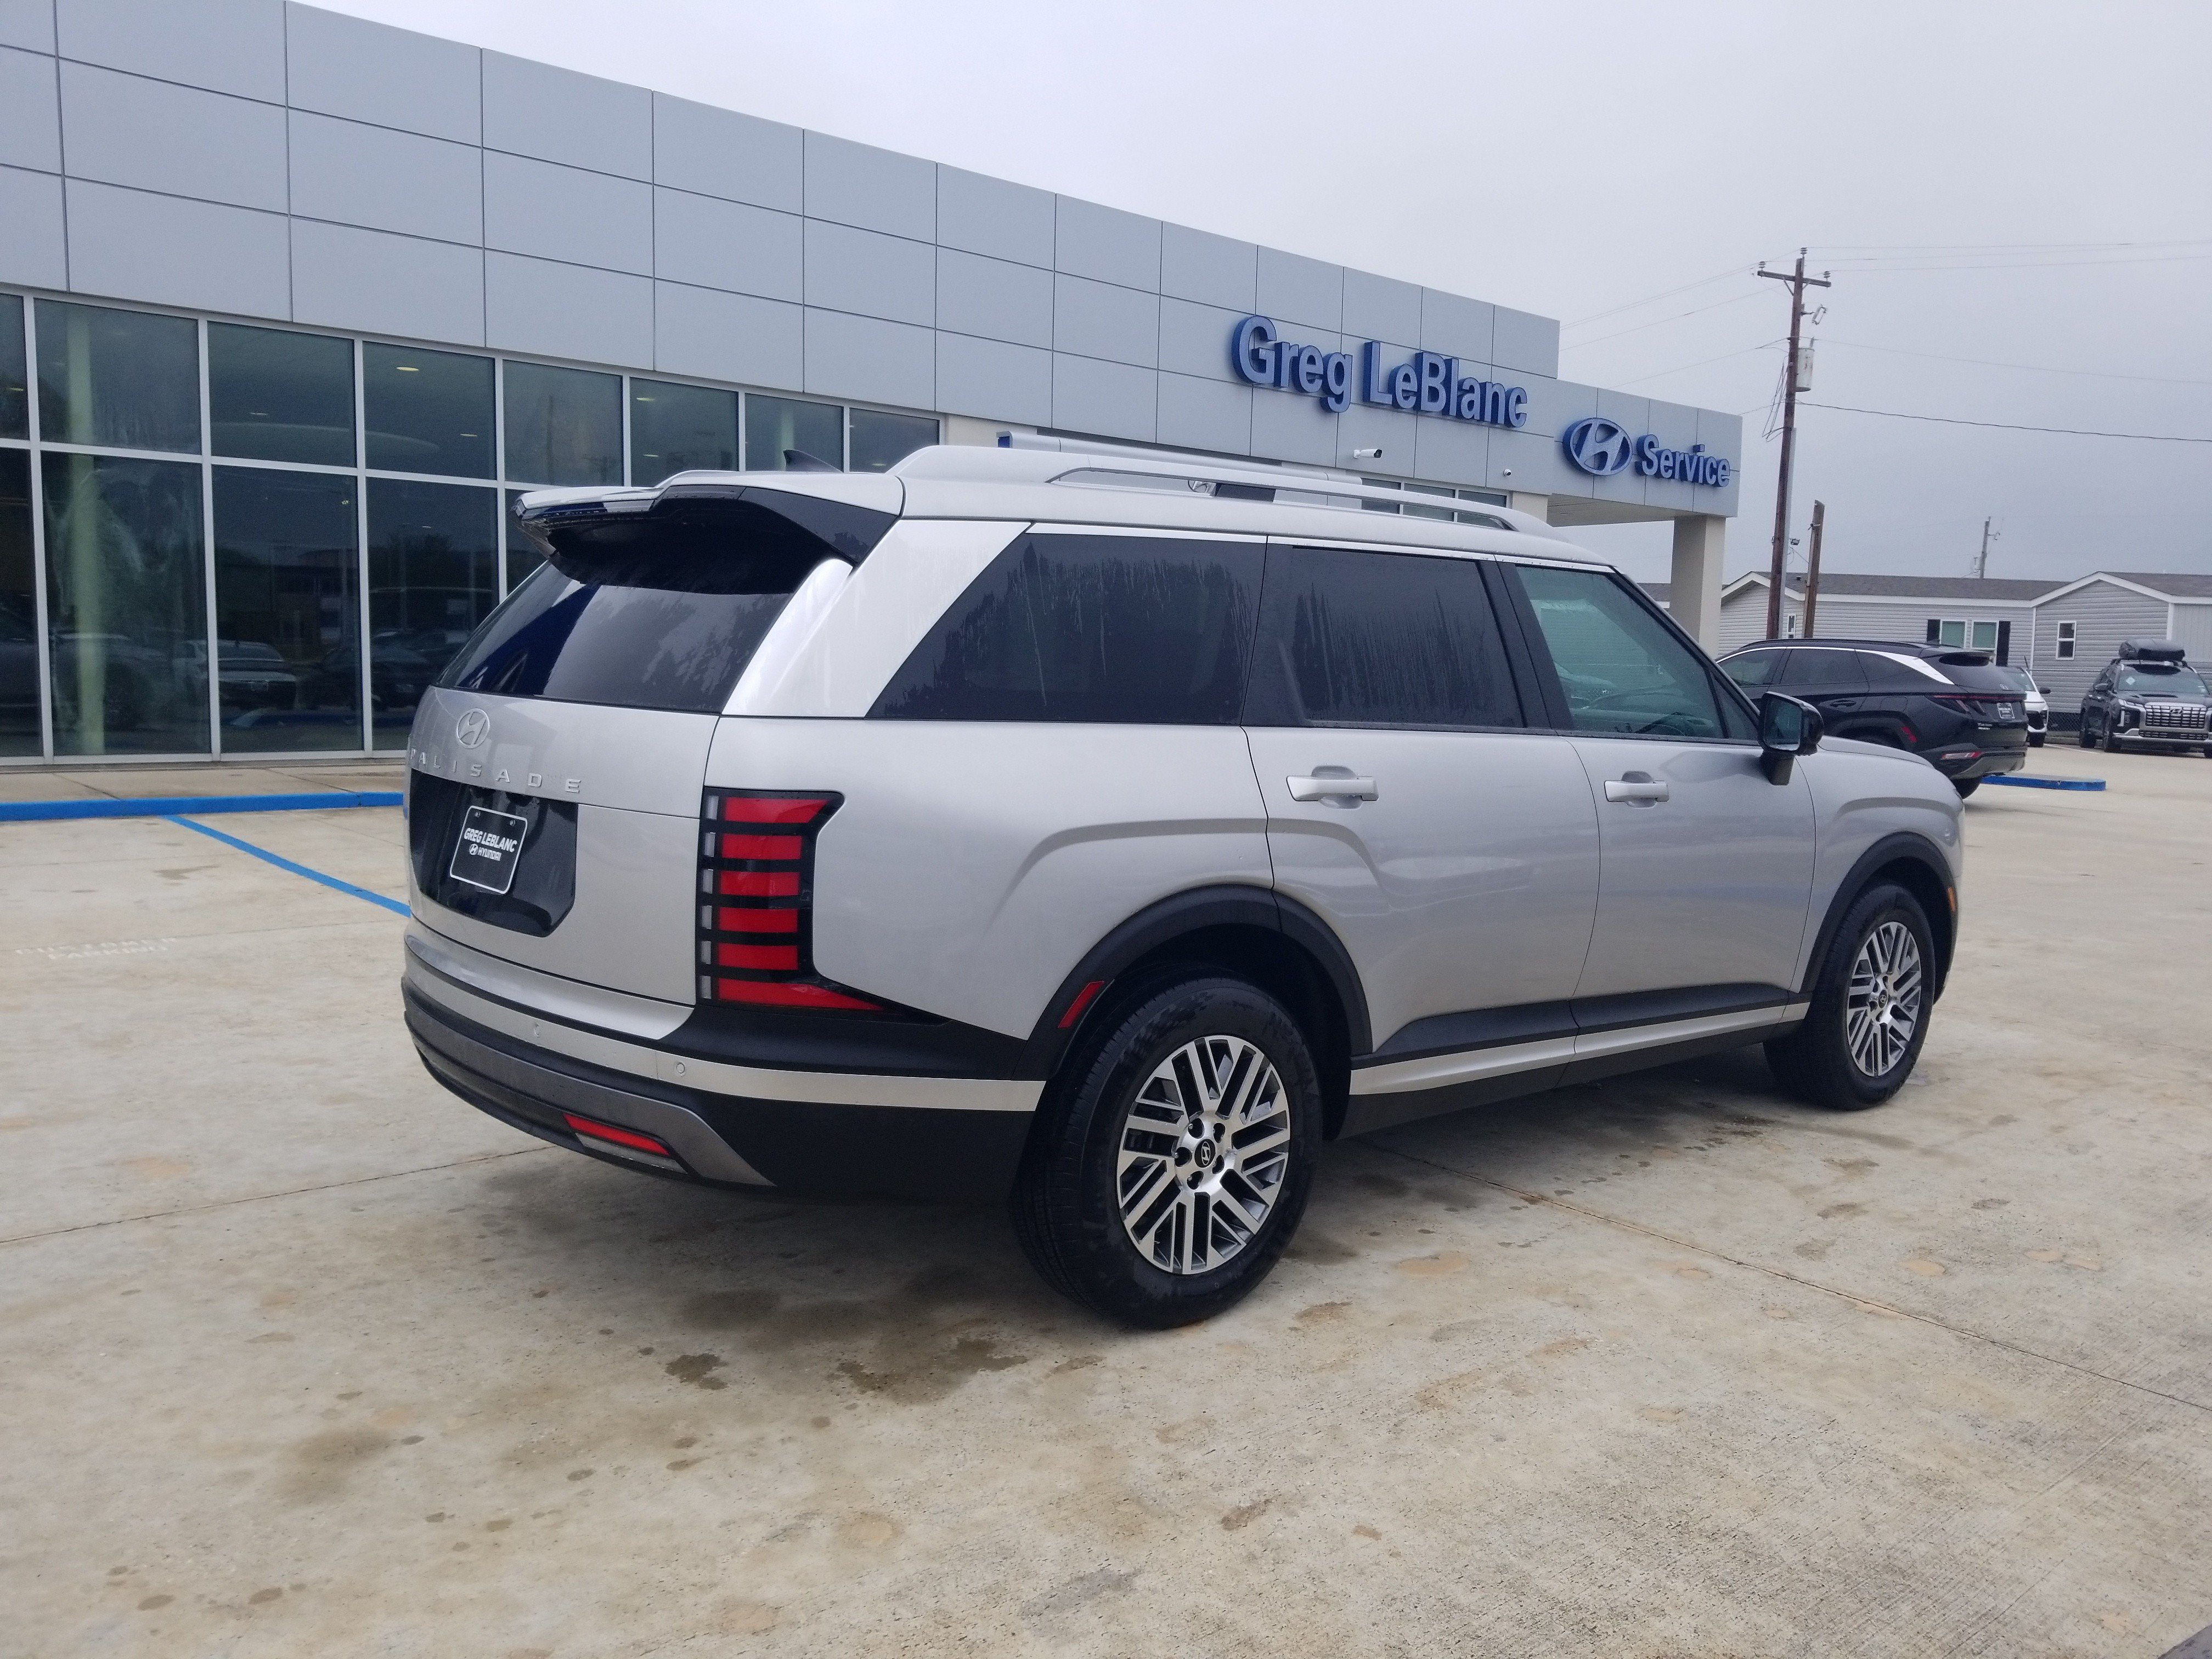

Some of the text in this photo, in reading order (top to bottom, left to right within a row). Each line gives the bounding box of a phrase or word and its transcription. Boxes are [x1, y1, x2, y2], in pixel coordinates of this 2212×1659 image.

[1231, 315, 1527, 428] Greg LeBlanc
[1635, 434, 1730, 487] Service
[410, 748, 582, 793] PALISADE
[464, 827, 517, 853] GREG LEBLANC
[477, 847, 502, 861] HYUNDAI
